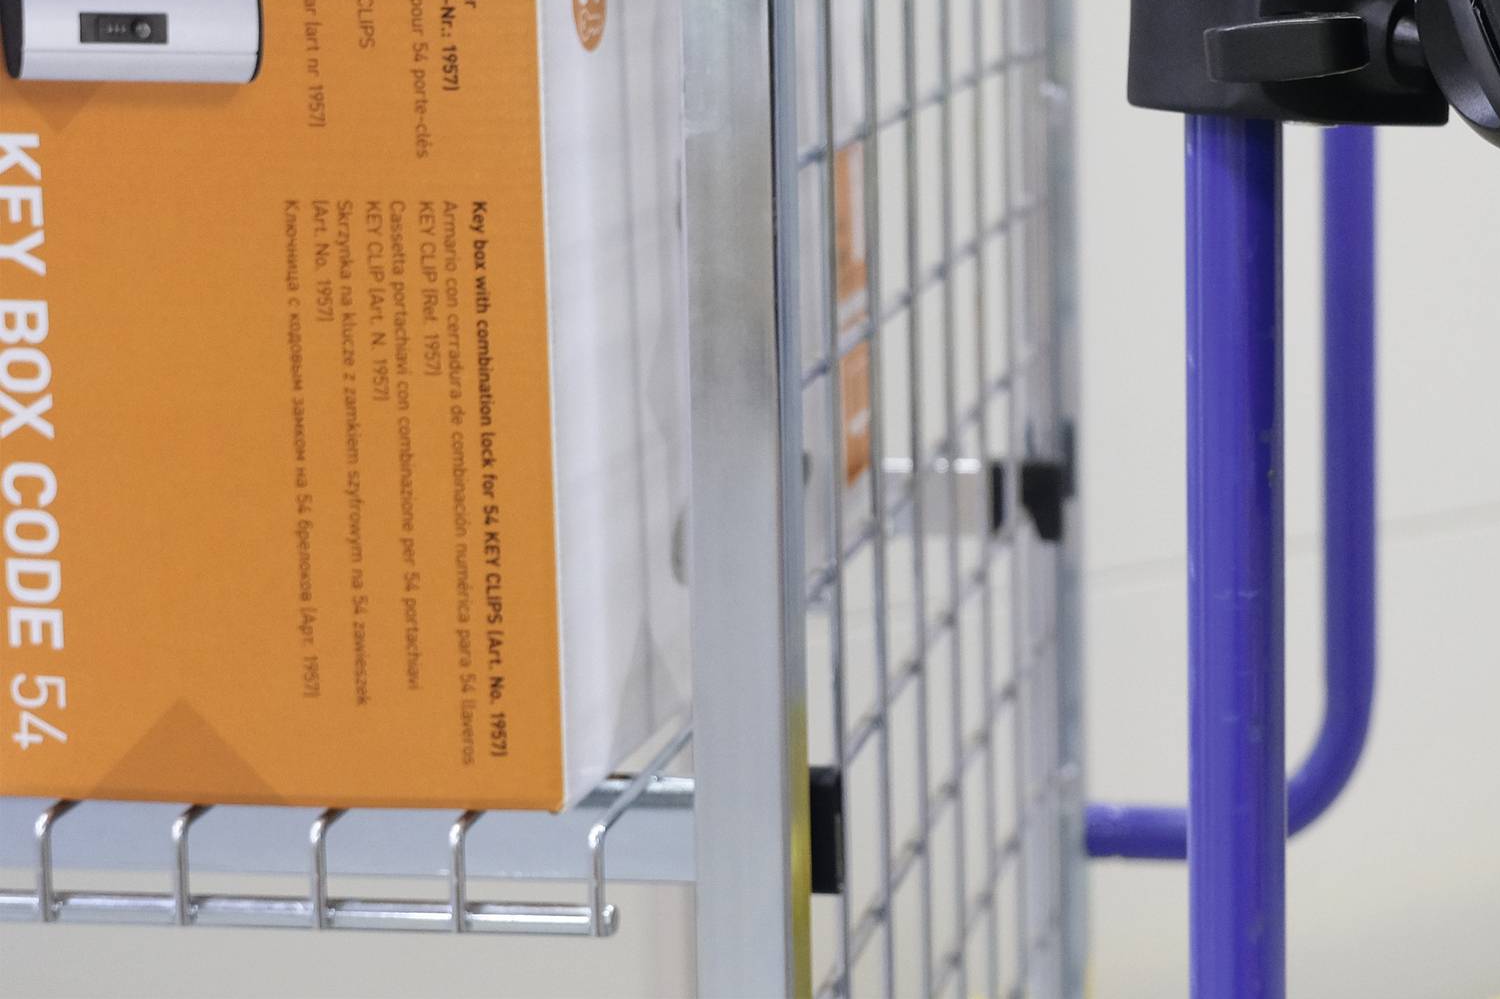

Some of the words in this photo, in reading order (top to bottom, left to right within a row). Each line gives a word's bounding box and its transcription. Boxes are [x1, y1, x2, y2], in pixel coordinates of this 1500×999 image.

[304, 21, 322, 51] (art
[412, 42, 429, 62] 54
[307, 58, 319, 77] nr
[442, 45, 460, 91] 1957)
[308, 84, 326, 127] 1957)
[410, 69, 433, 159] porte-clés
[311, 200, 329, 236] (Art.
[365, 201, 382, 236] KEY
[419, 201, 435, 236] KEY
[443, 200, 458, 272] Armario
[470, 201, 487, 233] Key
[389, 200, 406, 275] Cassetta
[473, 239, 488, 270] box
[315, 243, 330, 271] No.
[366, 241, 385, 283] CLIP
[420, 242, 438, 283] CLIP
[316, 279, 334, 322] 1957)
[368, 288, 386, 324] (Art.
[421, 288, 438, 322] (Ref.
[445, 277, 458, 308] con
[475, 276, 490, 314] with
[371, 332, 386, 350] N.
[389, 281, 410, 375] portachiavi
[0, 299, 55, 440] BOX
[424, 334, 442, 376] 1957)
[447, 313, 464, 400] cerradura
[476, 319, 493, 426] combination
[372, 358, 390, 401] 1957)
[396, 380, 410, 411] con
[450, 405, 466, 426] de
[481, 432, 496, 468] lock
[397, 416, 414, 532] combinazione
[451, 431, 471, 537] combinación
[482, 474, 498, 499] for
[483, 505, 499, 526] 54
[1, 462, 64, 650] CODE
[399, 538, 415, 565] per
[484, 531, 500, 567] KEY
[403, 572, 420, 592] 54
[455, 543, 473, 623] numérica
[485, 573, 503, 625] CLIPS
[401, 598, 422, 690] portachiavi
[455, 629, 471, 668] para
[487, 630, 503, 670] (Art.
[459, 673, 476, 693] 54
[490, 676, 504, 704] No.
[10, 673, 68, 750] 54
[490, 712, 507, 757] 1957)
